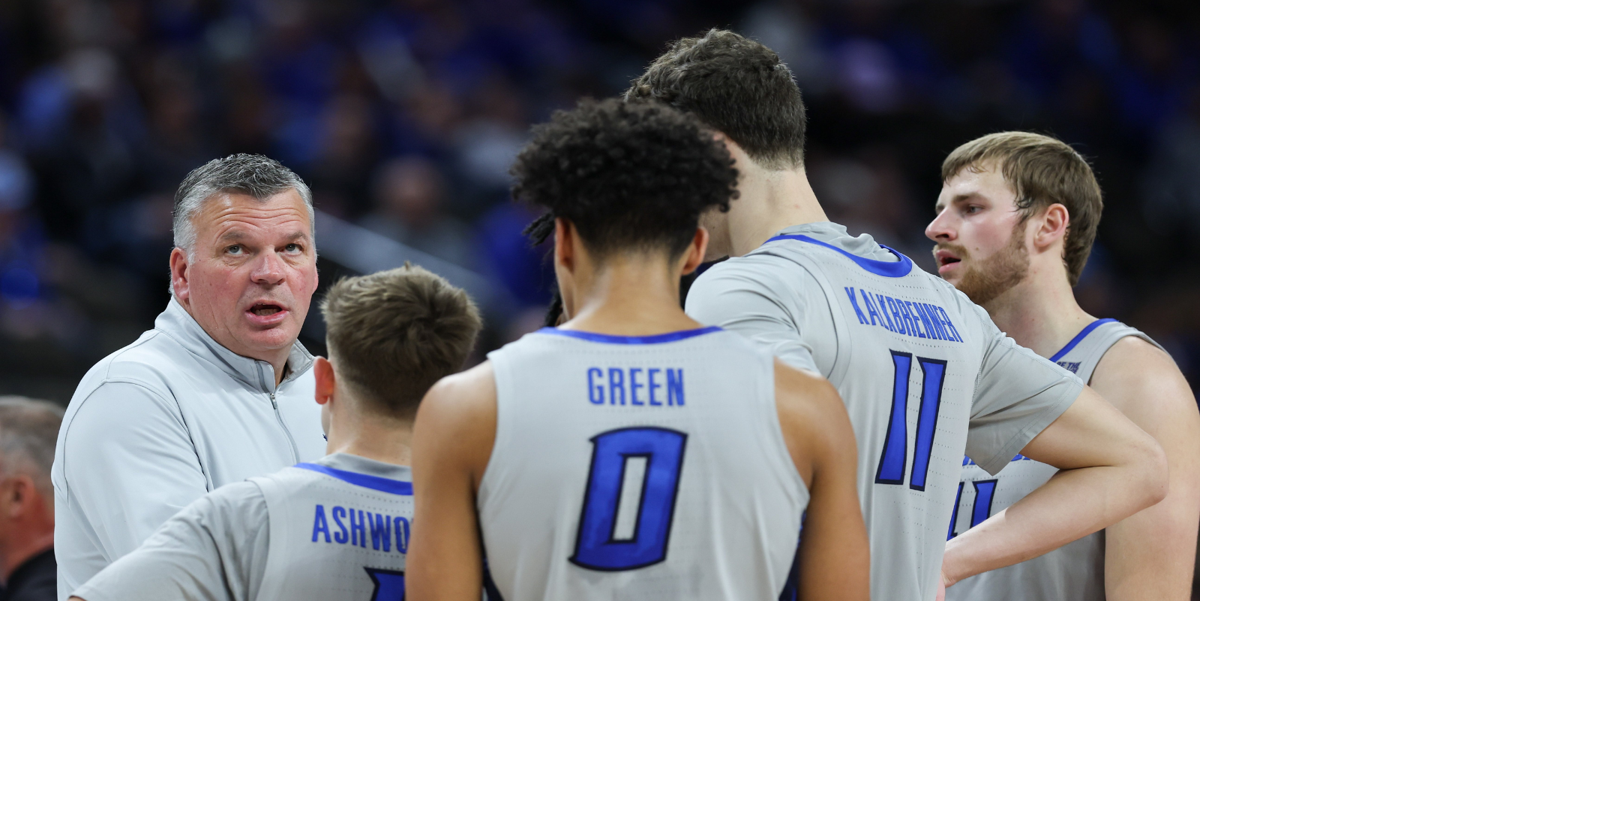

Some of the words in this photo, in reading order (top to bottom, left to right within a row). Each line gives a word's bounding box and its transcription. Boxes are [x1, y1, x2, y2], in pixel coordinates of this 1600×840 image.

[844, 287, 964, 343] KALKBRENNER
[587, 367, 685, 406] GREEN
[873, 348, 948, 492] 11
[567, 425, 688, 572] 0
[311, 504, 413, 554] ASHWO
